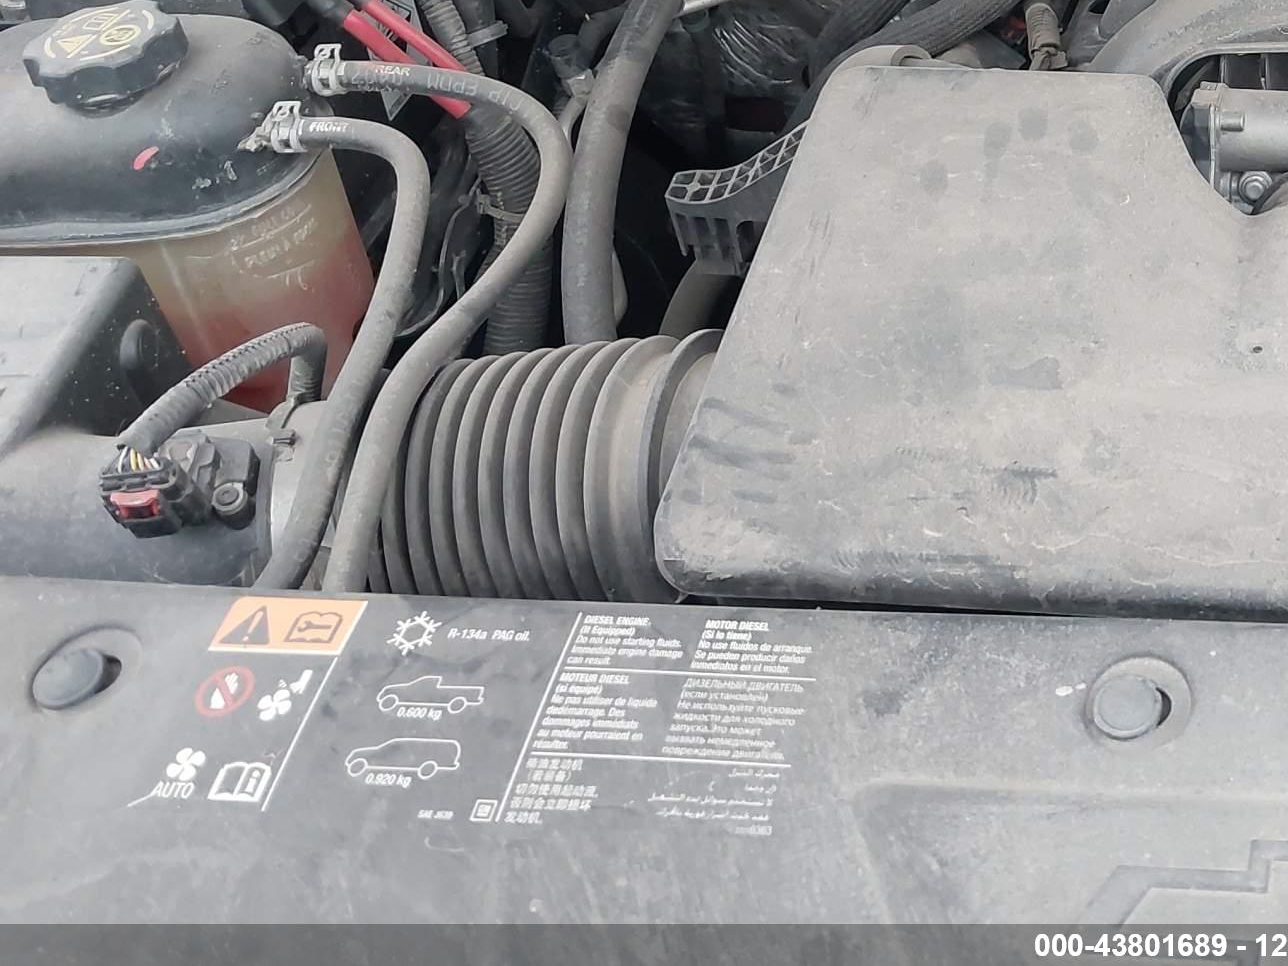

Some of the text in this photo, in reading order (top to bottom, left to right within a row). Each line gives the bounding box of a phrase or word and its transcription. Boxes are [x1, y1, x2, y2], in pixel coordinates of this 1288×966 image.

[374, 65, 411, 77] REAR
[309, 121, 349, 133] FRONT
[584, 615, 614, 625] DIESEL
[705, 619, 769, 631] MOTOR DIESEL
[447, 628, 531, 642] R-134a PAG oil.
[591, 626, 636, 636] Equipped)
[701, 629, 752, 642] (Si lo tiene)
[575, 635, 588, 643] Do
[589, 636, 603, 644] not
[605, 637, 621, 645] use
[622, 637, 655, 648] starting
[698, 639, 710, 649] No
[711, 641, 728, 650] use
[730, 642, 759, 652] fluidos
[759, 643, 772, 652] de
[571, 644, 684, 659] Immediate engine damage
[694, 649, 705, 659] Se
[706, 650, 740, 661] pueden
[740, 652, 778, 663] producir
[567, 656, 583, 664] can
[740, 663, 752, 672] en
[752, 664, 762, 672] el
[559, 672, 630, 684] MOTEUR DIESEL
[683, 677, 804, 693] ДИЗЕЛЬНЫЙ ДВИГАТЕЛЬ
[551, 694, 564, 704] Ne
[564, 696, 582, 705] pas
[614, 697, 627, 706] de
[627, 697, 658, 708] liquide
[677, 699, 691, 709] Не
[397, 706, 442, 721] 0.600 kg
[607, 707, 627, 717] Des
[541, 716, 592, 729] dommages
[672, 712, 796, 726] жидкости для холодного
[536, 729, 644, 741] au moteur pourraient en
[365, 773, 412, 789] 0.920 kg
[152, 781, 196, 799] AUTO
[417, 809, 434, 819] SAE
